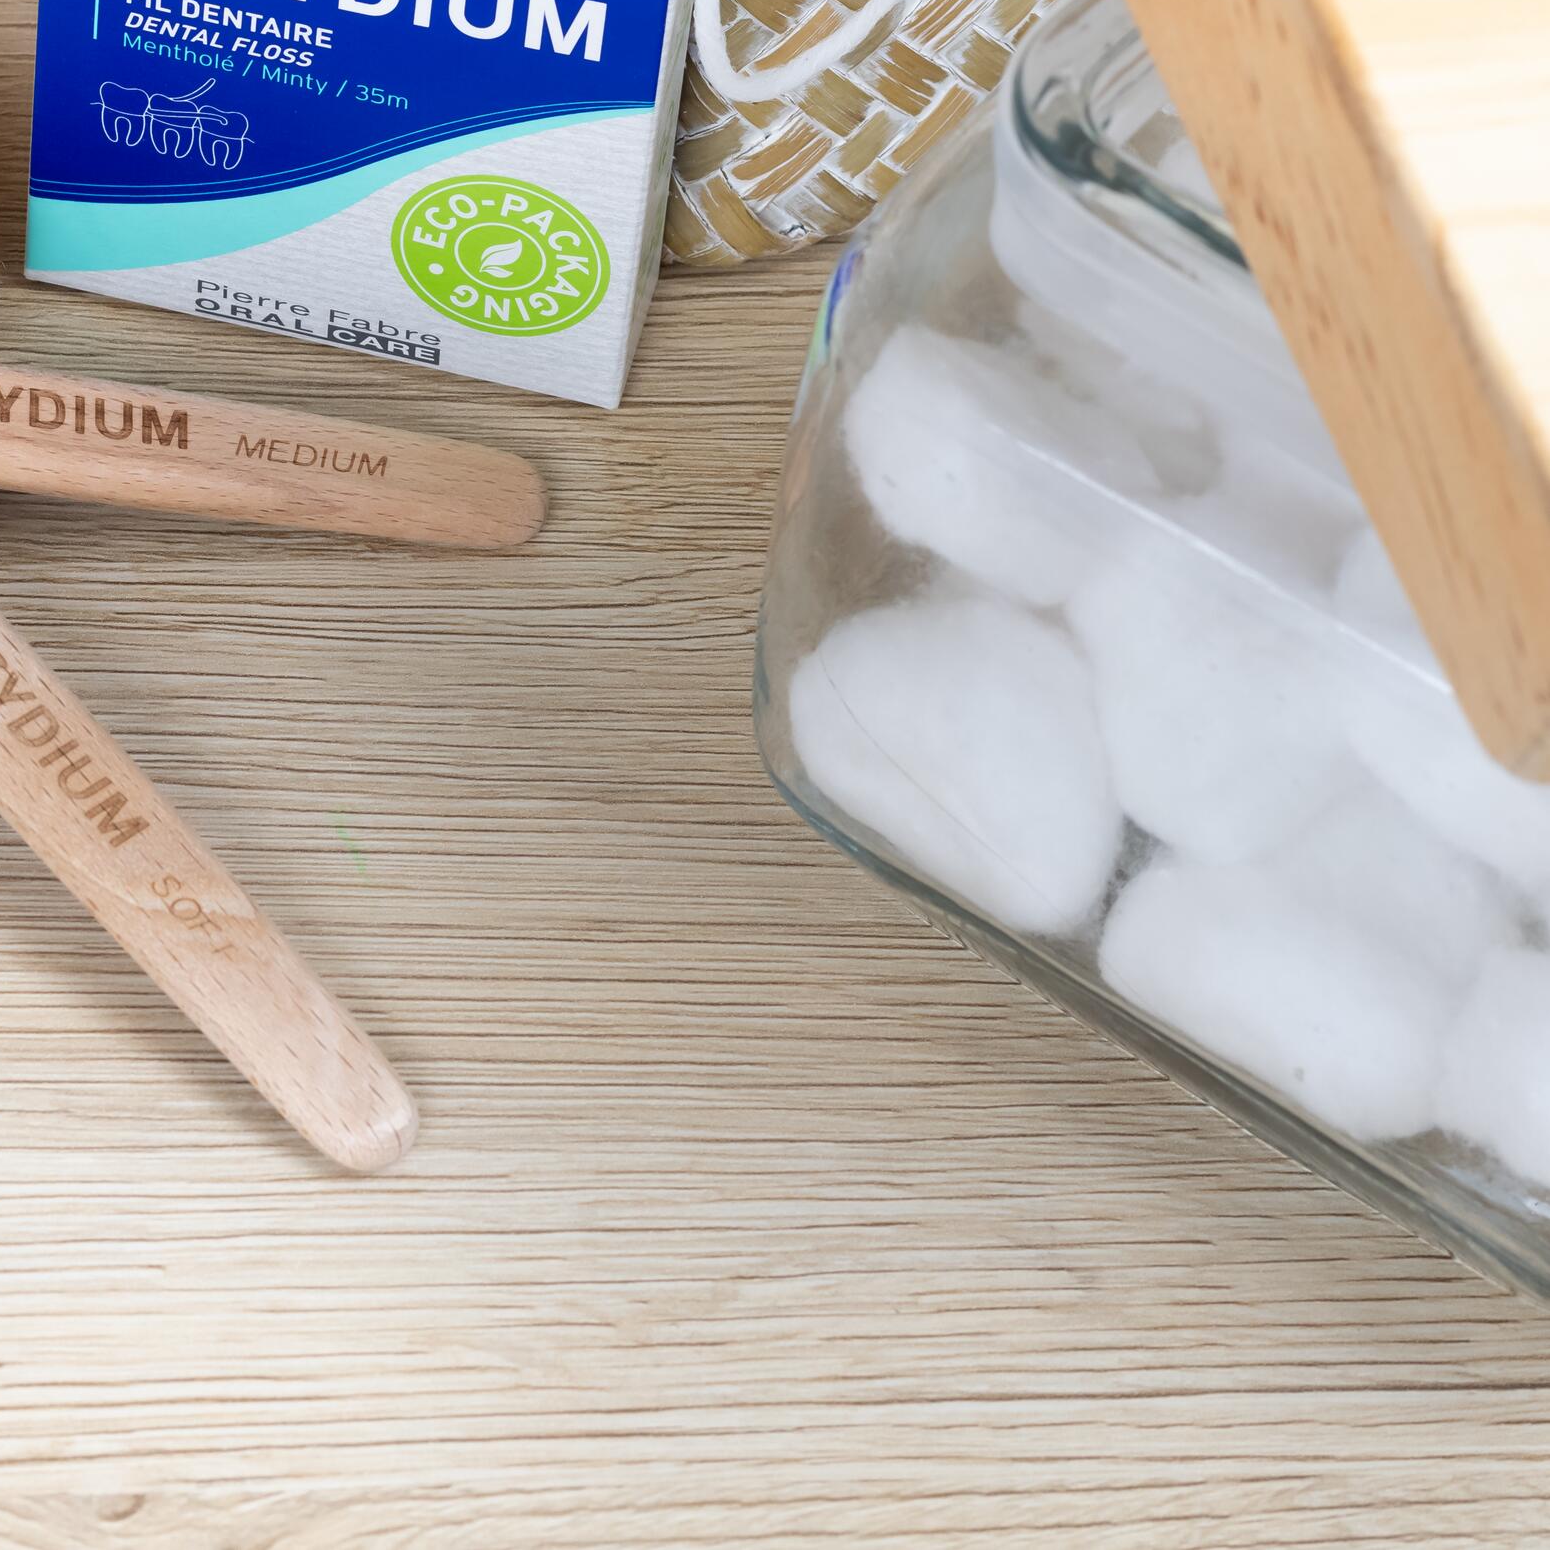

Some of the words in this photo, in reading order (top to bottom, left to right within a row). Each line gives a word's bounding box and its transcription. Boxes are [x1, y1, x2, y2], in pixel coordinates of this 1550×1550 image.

[123, 32, 234, 71] Mentholé
[262, 64, 328, 95] Minty
[356, 85, 408, 110] 35m
[125, 12, 224, 49] DENTAL
[231, 37, 314, 67] FLOSS
[412, 193, 590, 322] ECO-PACKAGING
[195, 297, 313, 333] ORAL
[332, 328, 436, 362] CARE
[197, 279, 310, 317] Pierre
[329, 309, 441, 346] Fabre
[235, 433, 388, 477] MEDIUM
